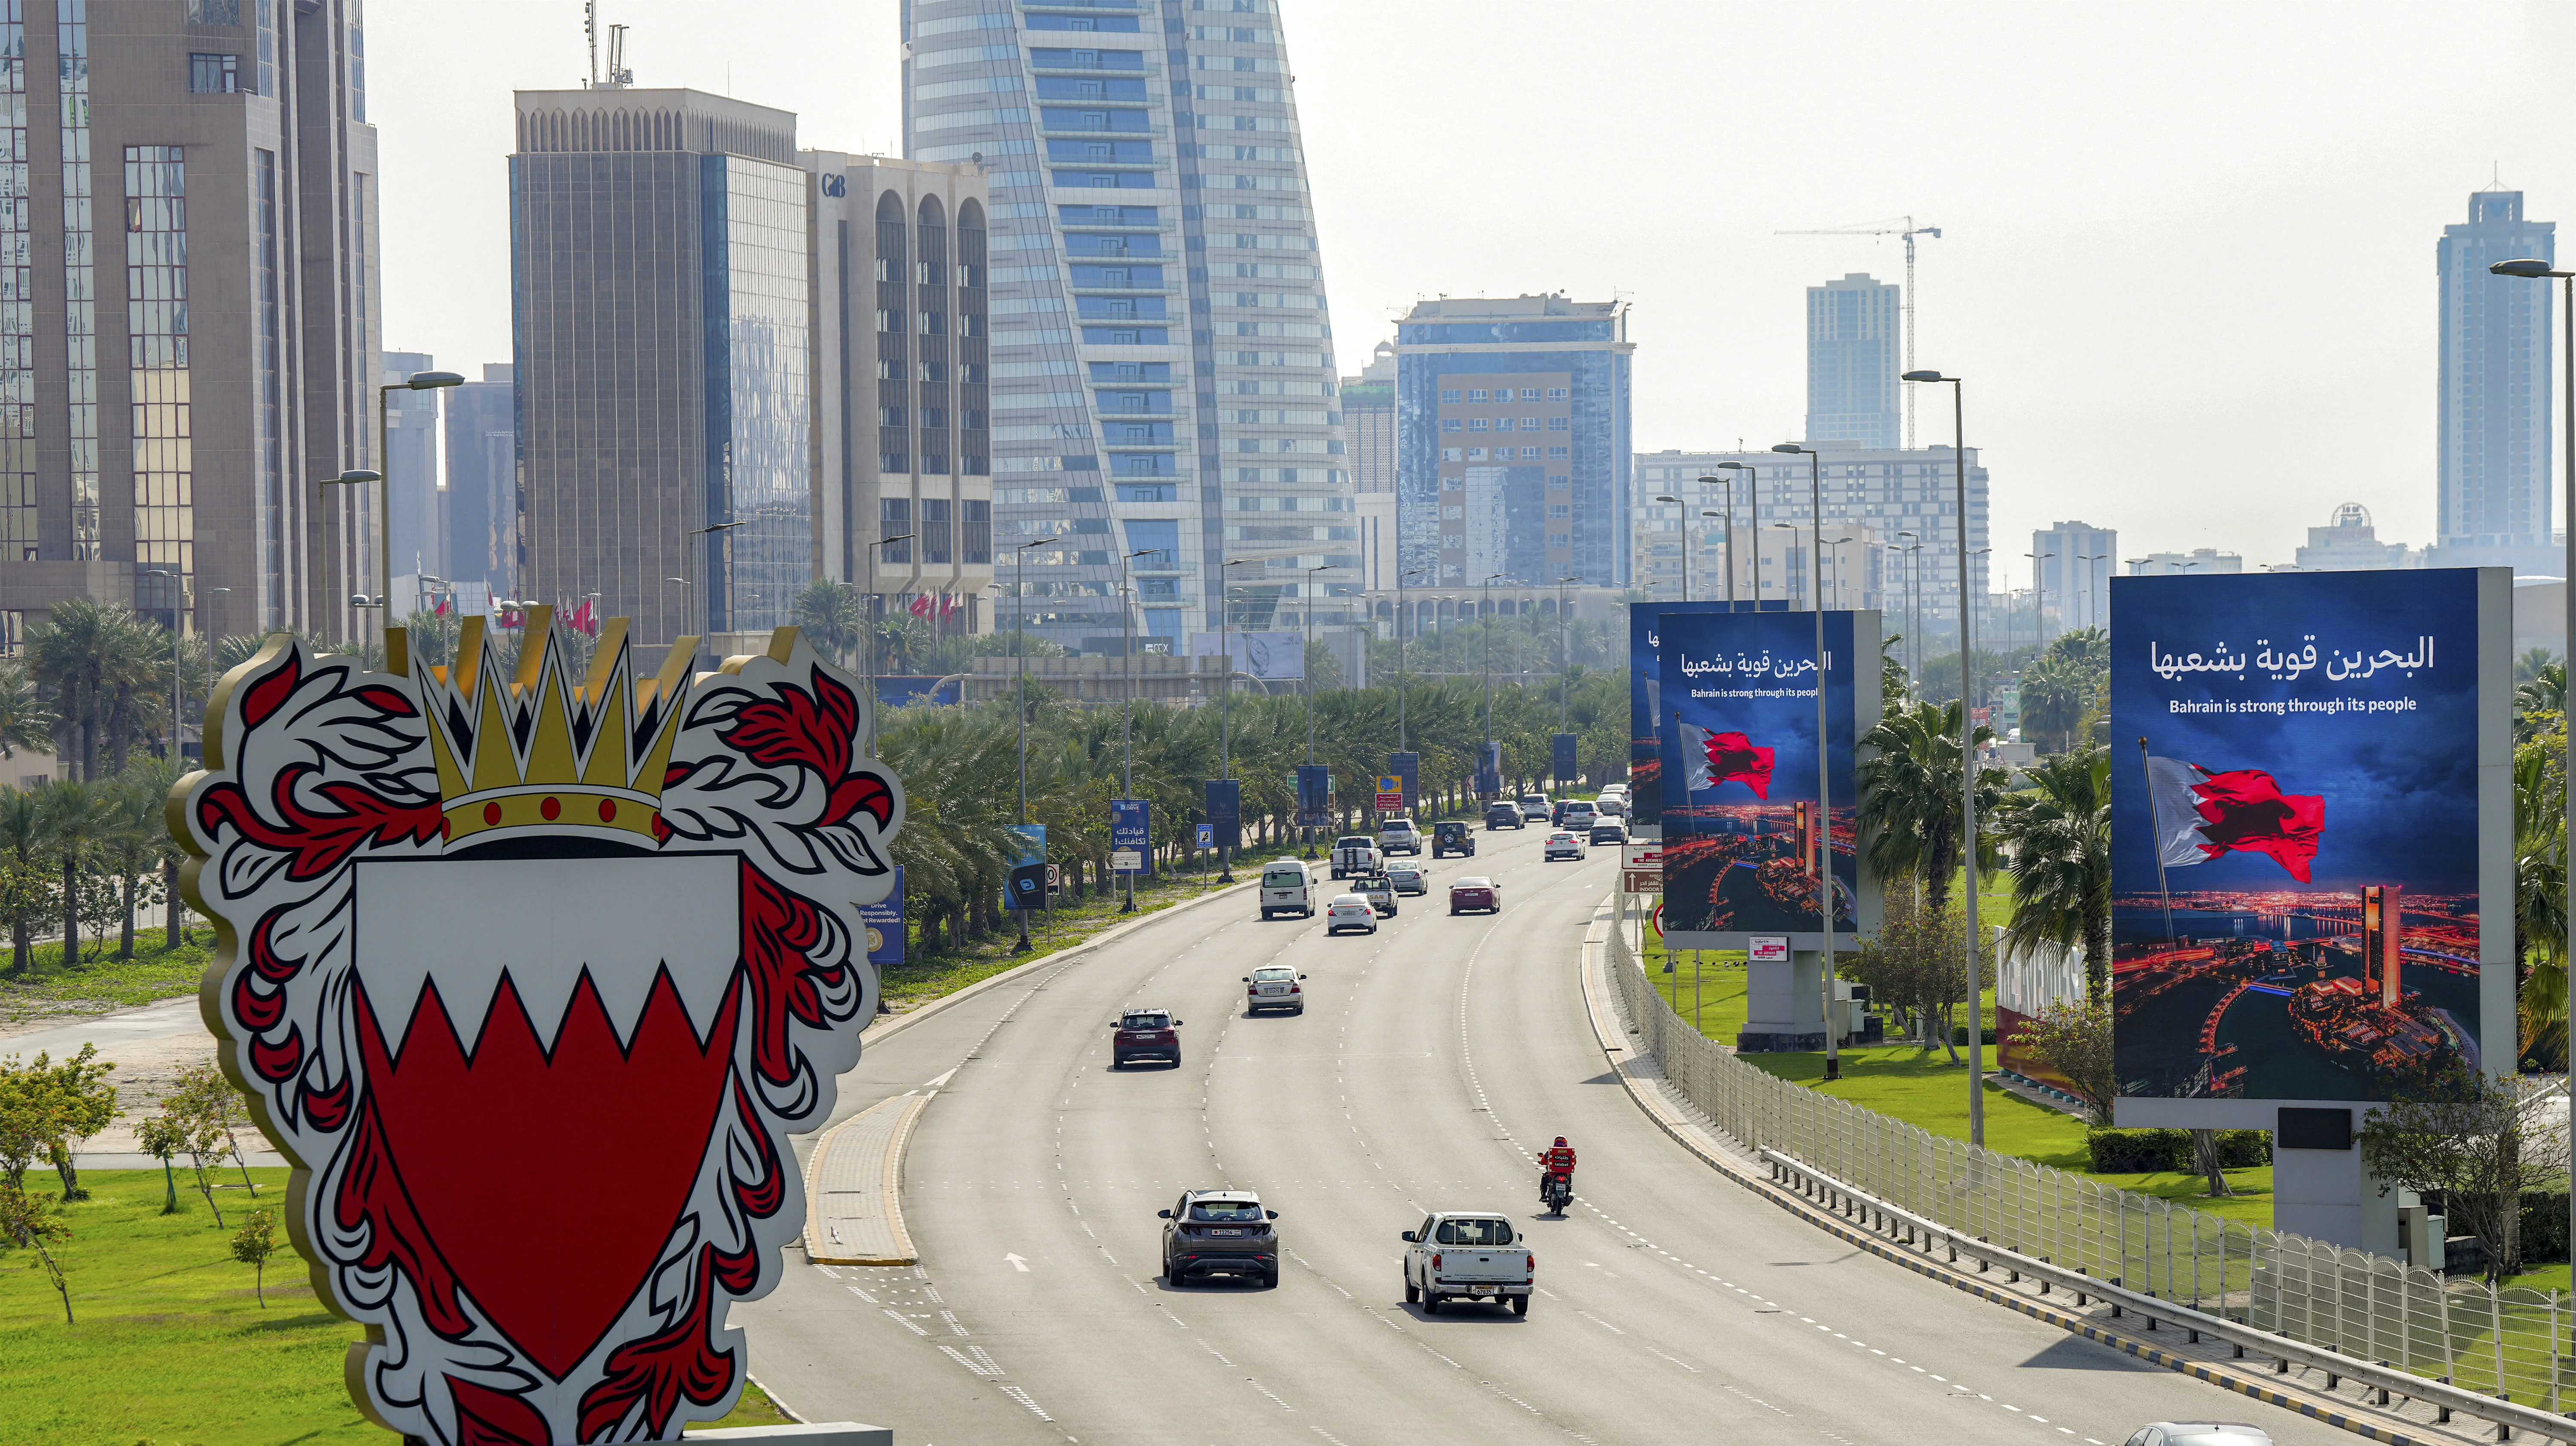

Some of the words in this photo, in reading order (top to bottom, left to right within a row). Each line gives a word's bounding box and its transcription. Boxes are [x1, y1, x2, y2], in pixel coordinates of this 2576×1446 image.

[1682, 654, 1732, 678] بشعبها
[1738, 650, 1770, 678] قوية
[2151, 641, 2246, 682] بشعبها
[2257, 634, 2317, 681] قوية
[2326, 636, 2434, 681] البحرين
[1692, 688, 1720, 697] Bahrain
[1721, 688, 1728, 697] is
[1728, 689, 1753, 699] strong
[1754, 688, 1784, 698] through
[1786, 688, 1795, 696] its
[1797, 687, 1818, 698] peopl
[2170, 699, 2222, 713] Bahrain
[2226, 699, 2237, 712] is
[2240, 700, 2285, 715] strong
[2287, 697, 2344, 715] through
[2348, 697, 2366, 711] its
[2369, 696, 2416, 714] people
[1116, 827, 1144, 836] قيادتك
[1048, 870, 1054, 880] 0
